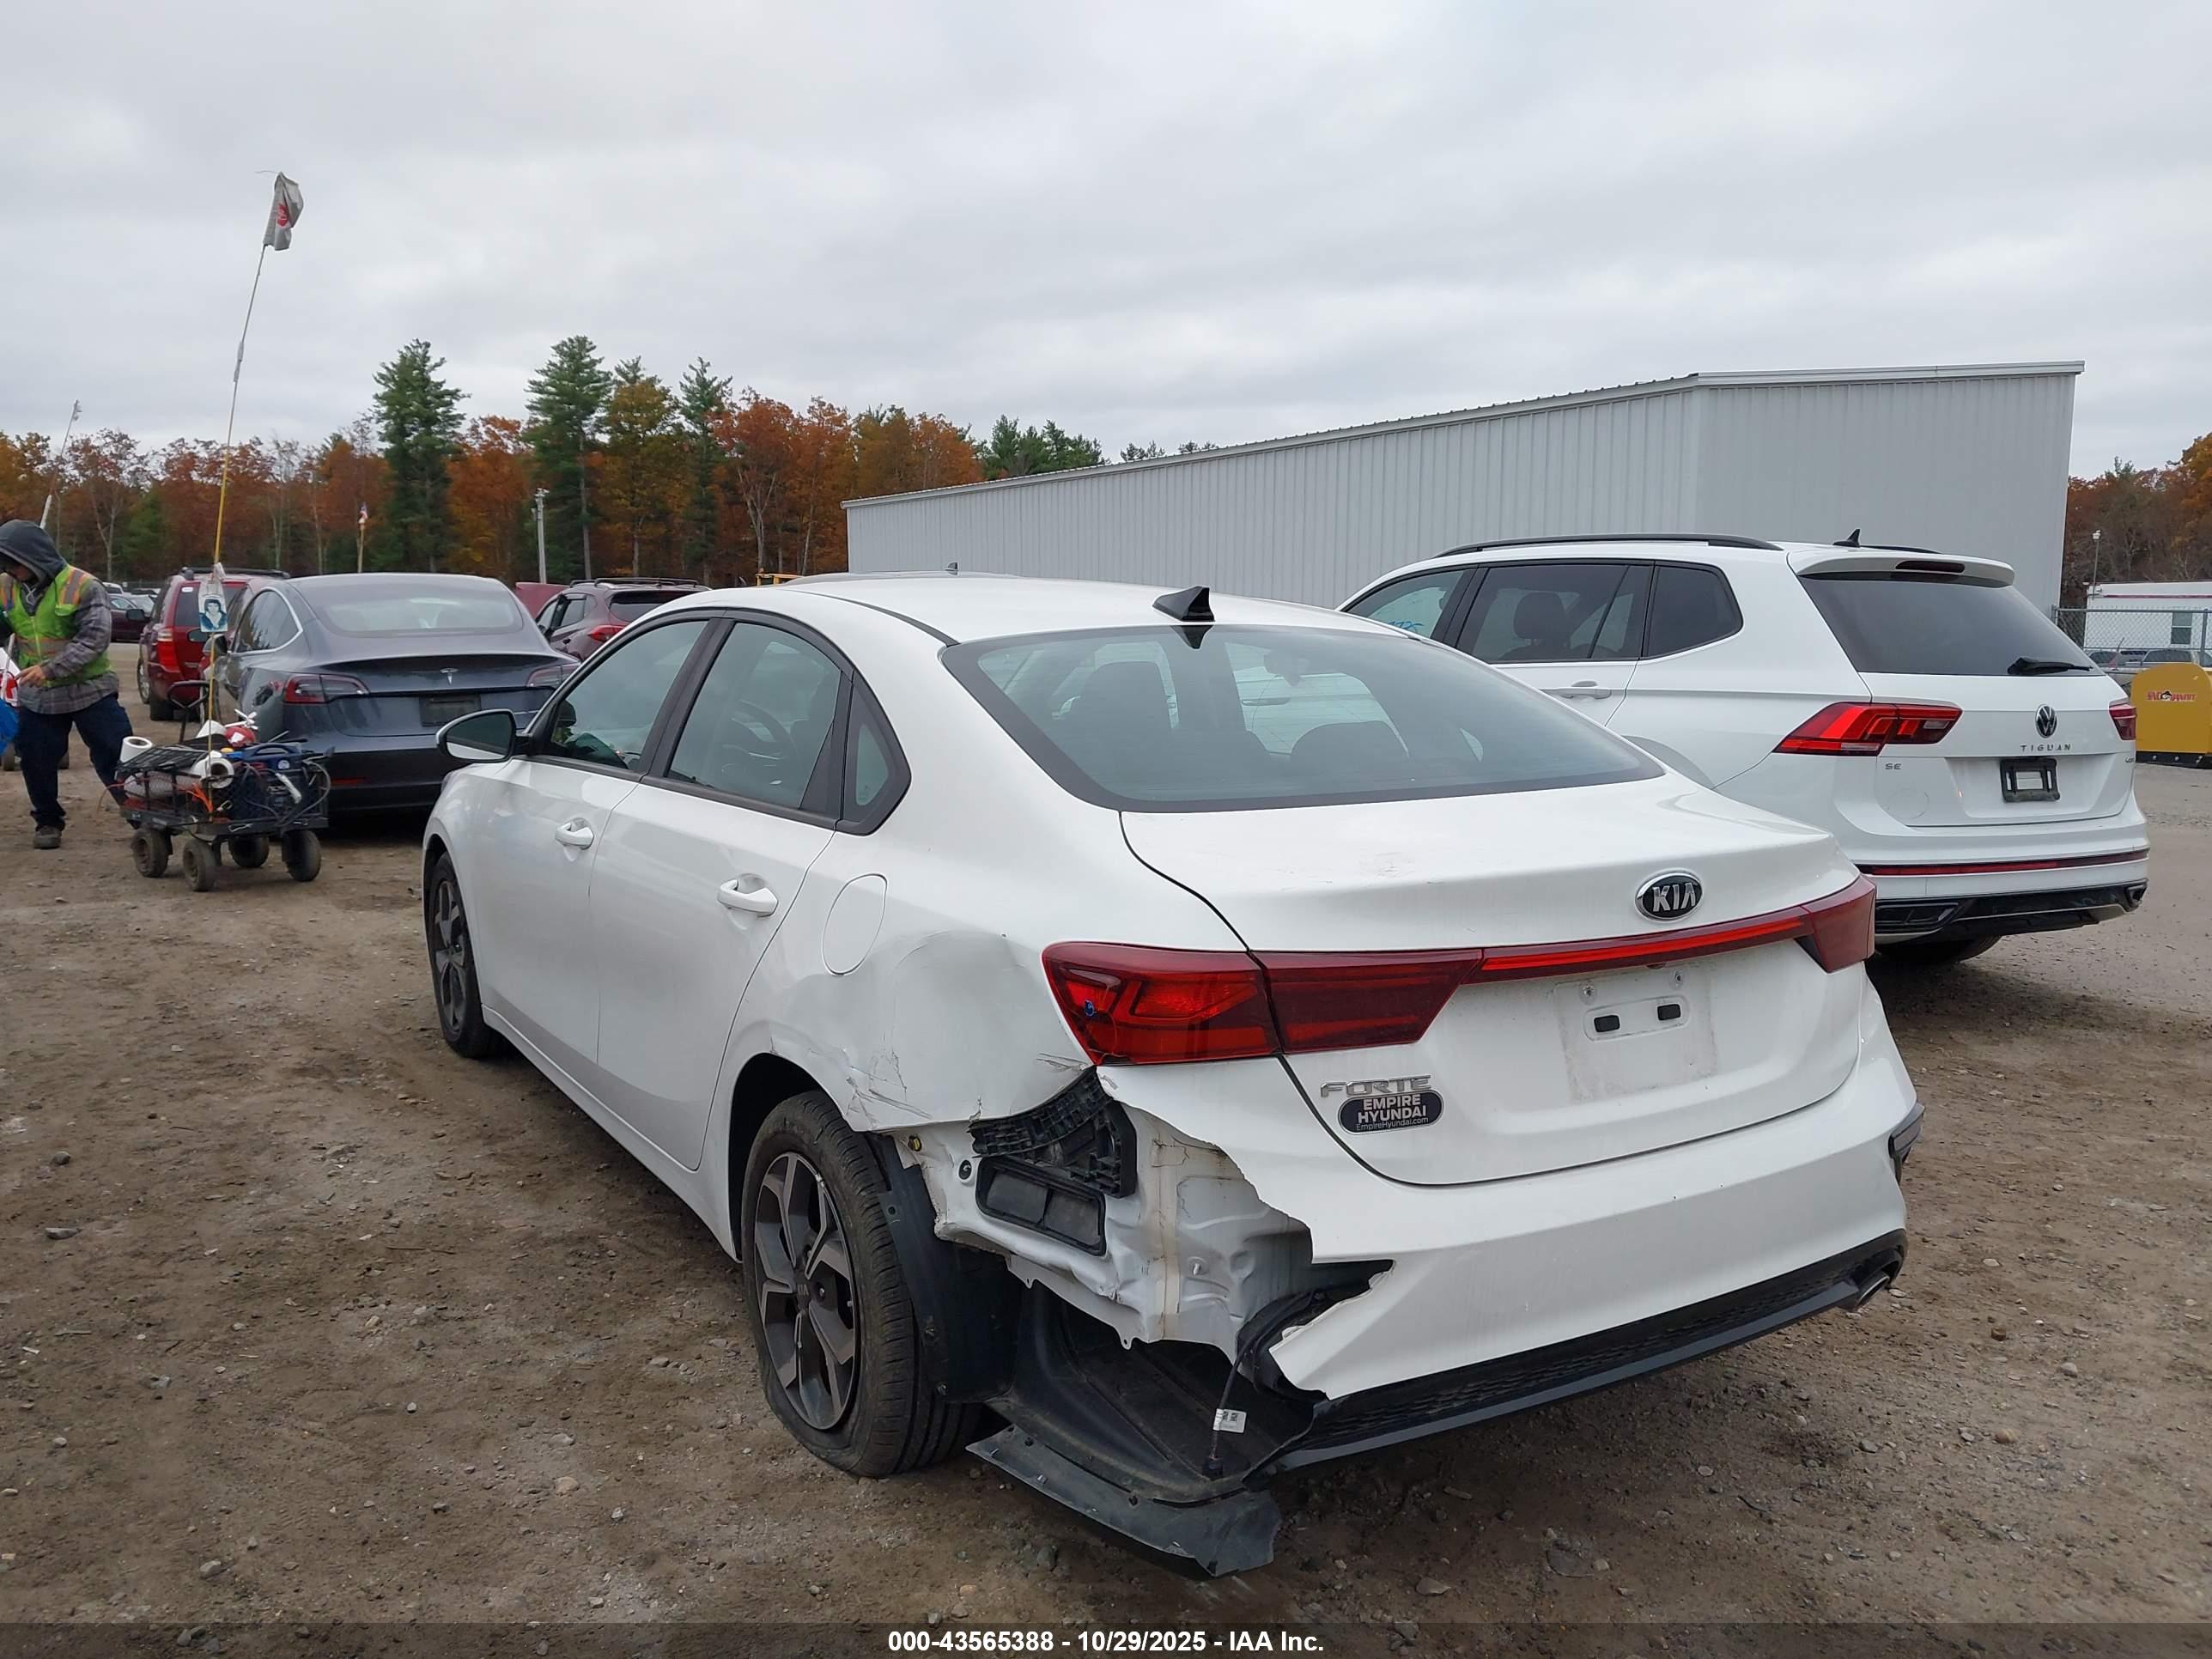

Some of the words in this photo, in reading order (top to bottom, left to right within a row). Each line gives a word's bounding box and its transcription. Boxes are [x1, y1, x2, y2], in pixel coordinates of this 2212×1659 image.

[2020, 744, 2071, 752] TIGUAN
[1652, 883, 1696, 912] KIA
[1320, 1074, 1432, 1098] FORTE
[1363, 1094, 1421, 1111] EMPIRE
[1358, 1105, 1427, 1124] HYUNDAI
[1356, 1116, 1429, 1132] EmpireHyundai.com
